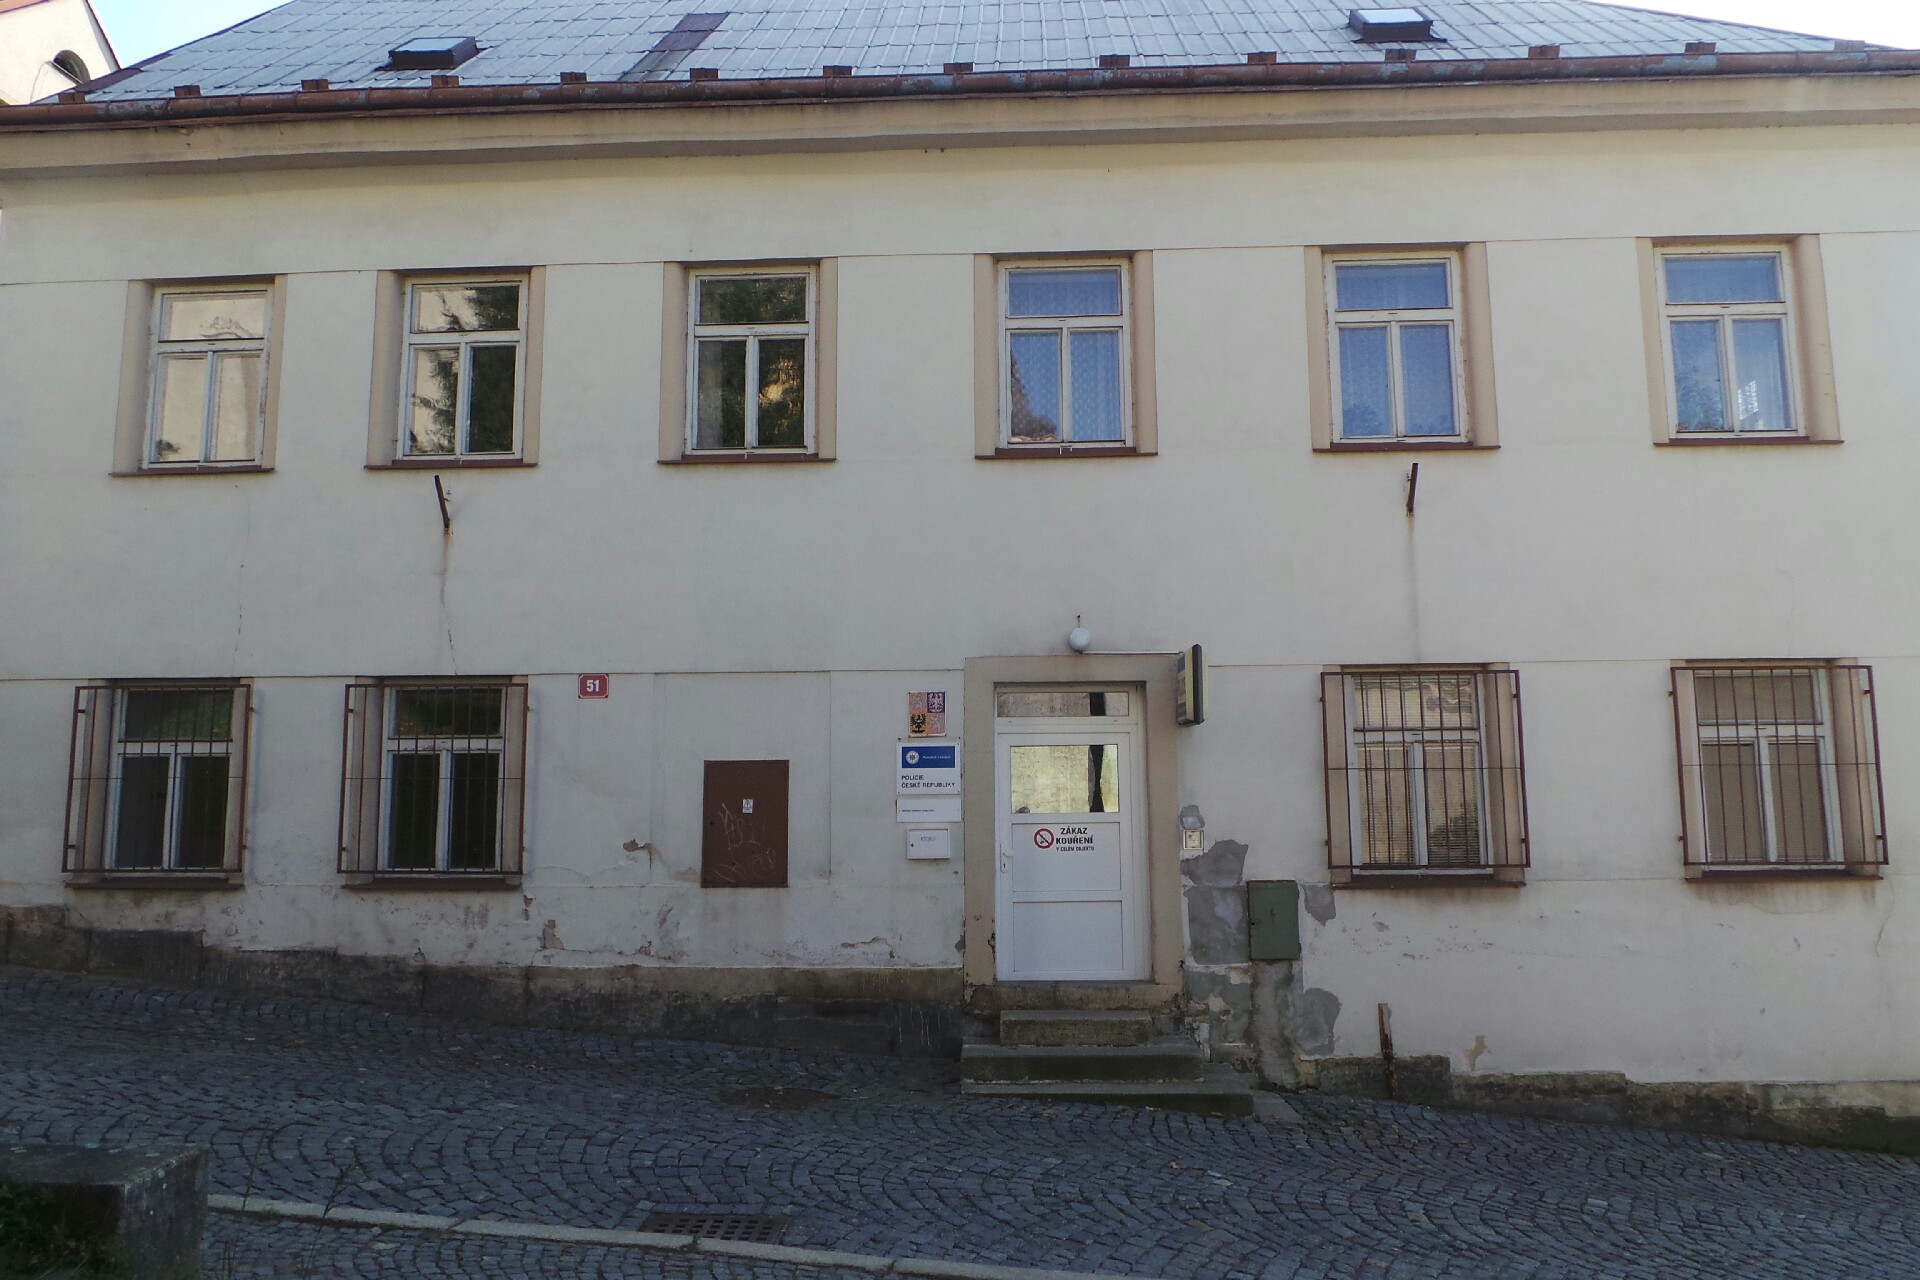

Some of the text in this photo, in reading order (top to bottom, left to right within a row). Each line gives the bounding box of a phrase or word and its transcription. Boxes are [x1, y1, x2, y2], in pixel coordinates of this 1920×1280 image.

[586, 679, 600, 692] 51
[1060, 826, 1088, 835] ZÁKAZ
[1055, 835, 1094, 845] KOUŘENÍ
